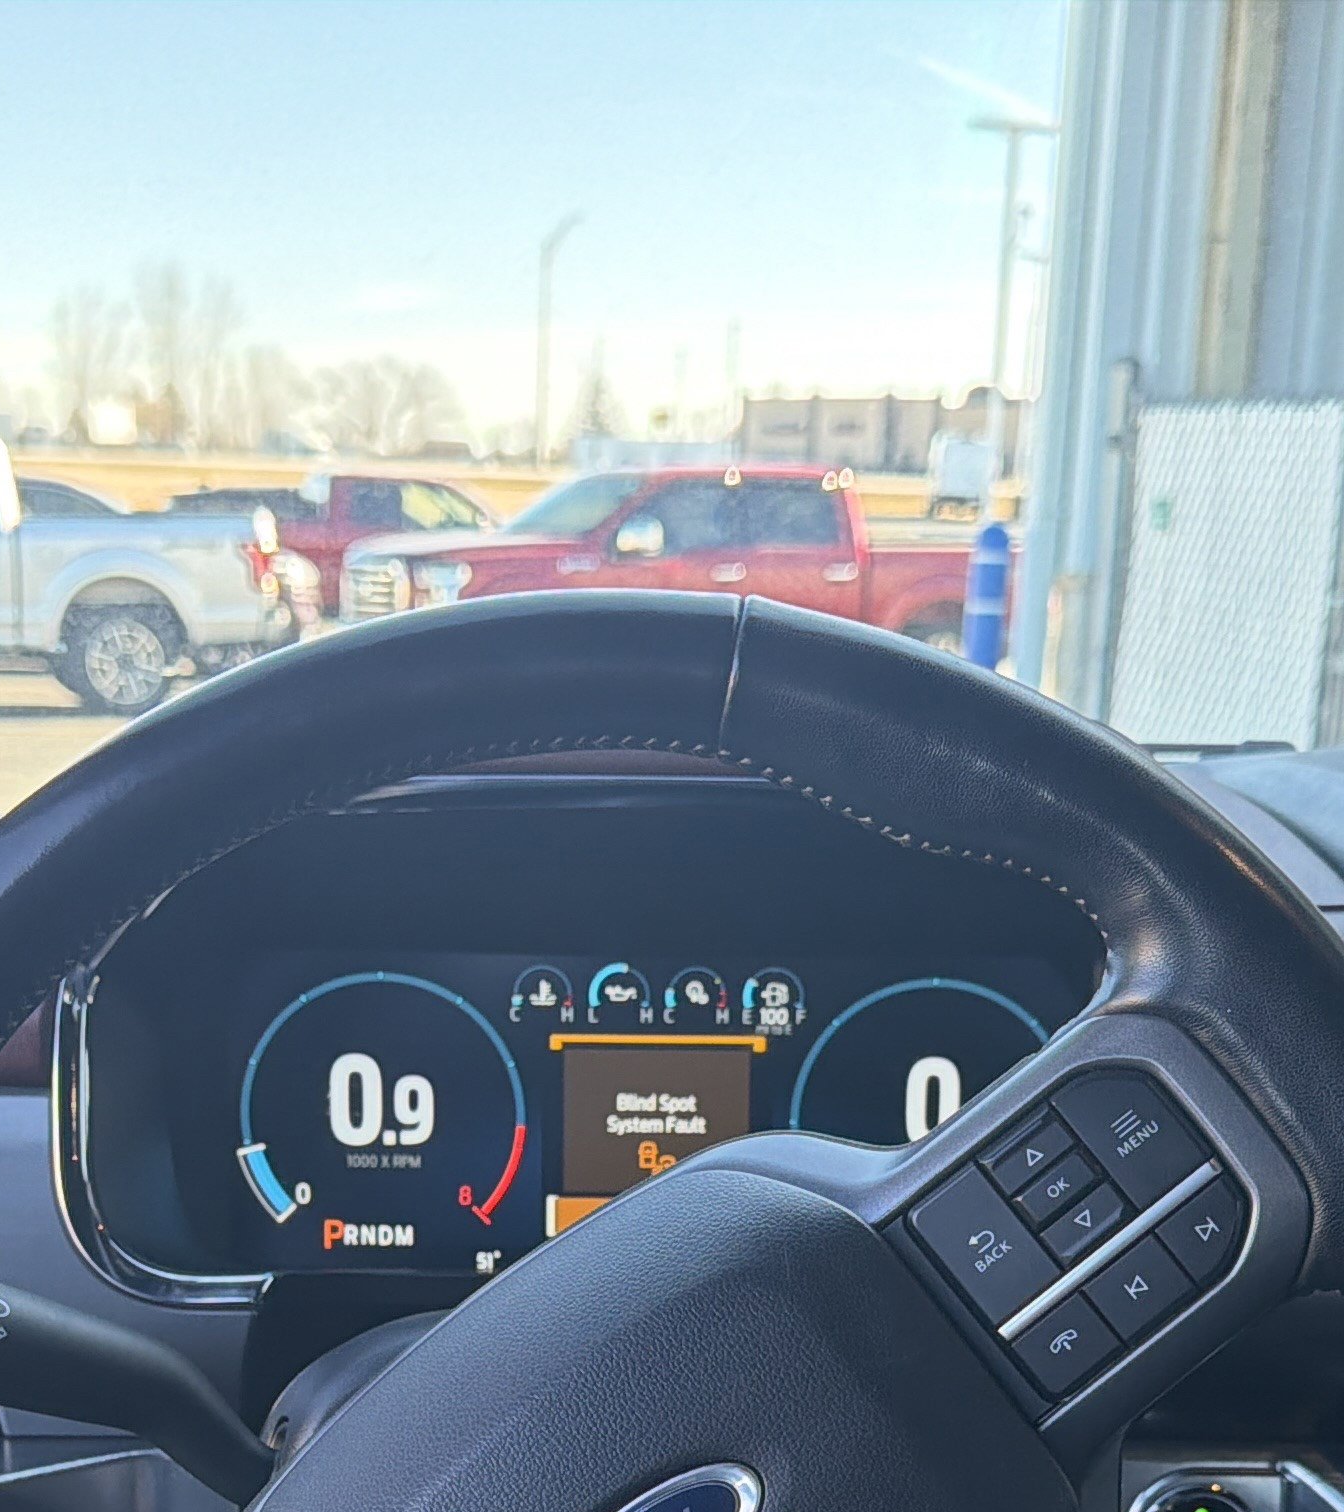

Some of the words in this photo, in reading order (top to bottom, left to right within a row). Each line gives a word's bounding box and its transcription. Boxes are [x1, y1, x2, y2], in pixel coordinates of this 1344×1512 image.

[509, 1008, 522, 1023] C
[560, 1008, 574, 1023] H
[587, 1008, 599, 1024] L
[639, 1008, 654, 1024] H
[663, 1008, 676, 1024] C
[715, 1008, 730, 1024] H
[742, 1009, 753, 1025] E
[759, 1007, 789, 1025] 100
[795, 1009, 807, 1025] F
[329, 1052, 435, 1147] 0.9
[616, 1093, 657, 1112] Blind
[659, 1093, 697, 1114] Spot
[606, 1115, 664, 1136] System
[666, 1115, 707, 1135] Fault
[1116, 1120, 1159, 1158] MENU
[346, 1153, 378, 1168] 1000
[393, 1154, 422, 1169] RPM
[295, 1182, 312, 1205] 0
[458, 1185, 473, 1206] 8
[1046, 1176, 1071, 1199] OK
[974, 1240, 1013, 1274] BACK
